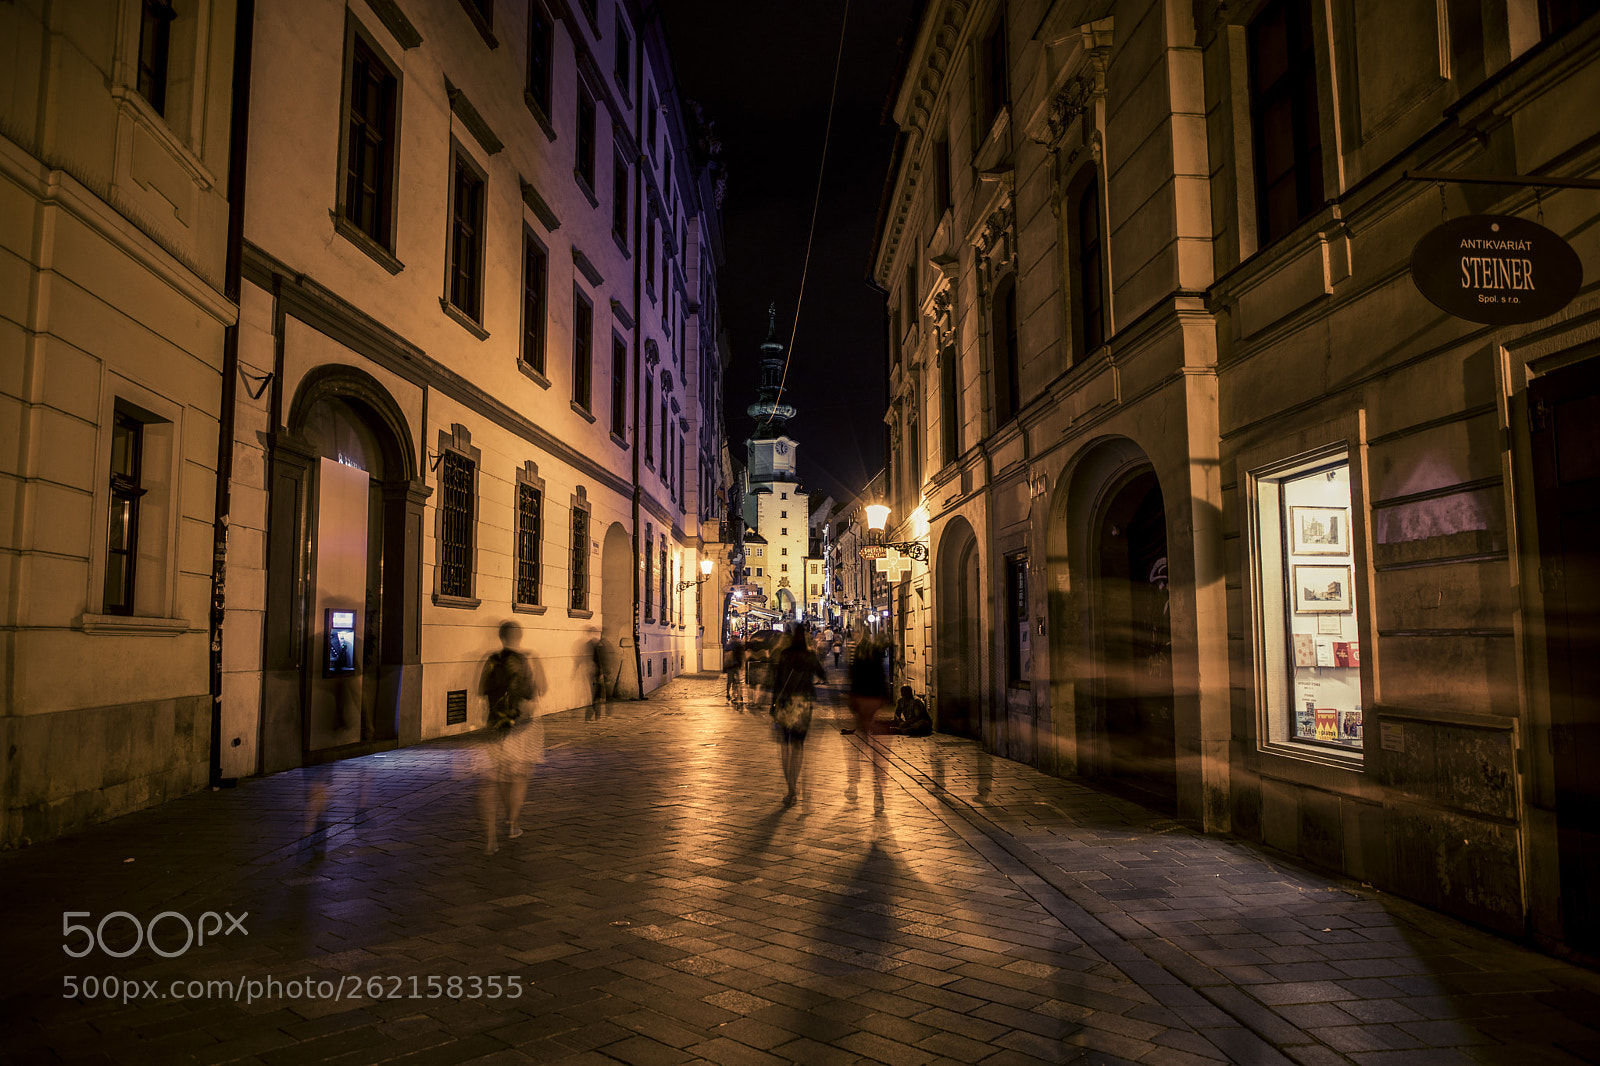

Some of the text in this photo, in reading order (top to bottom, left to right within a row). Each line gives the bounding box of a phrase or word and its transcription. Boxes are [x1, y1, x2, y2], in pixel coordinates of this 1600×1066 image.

[1460, 239, 1532, 251] ANTIKVARIÁT
[1461, 256, 1535, 290] STEINER
[1478, 294, 1499, 304] Spol.
[1508, 296, 1521, 304] r.o.
